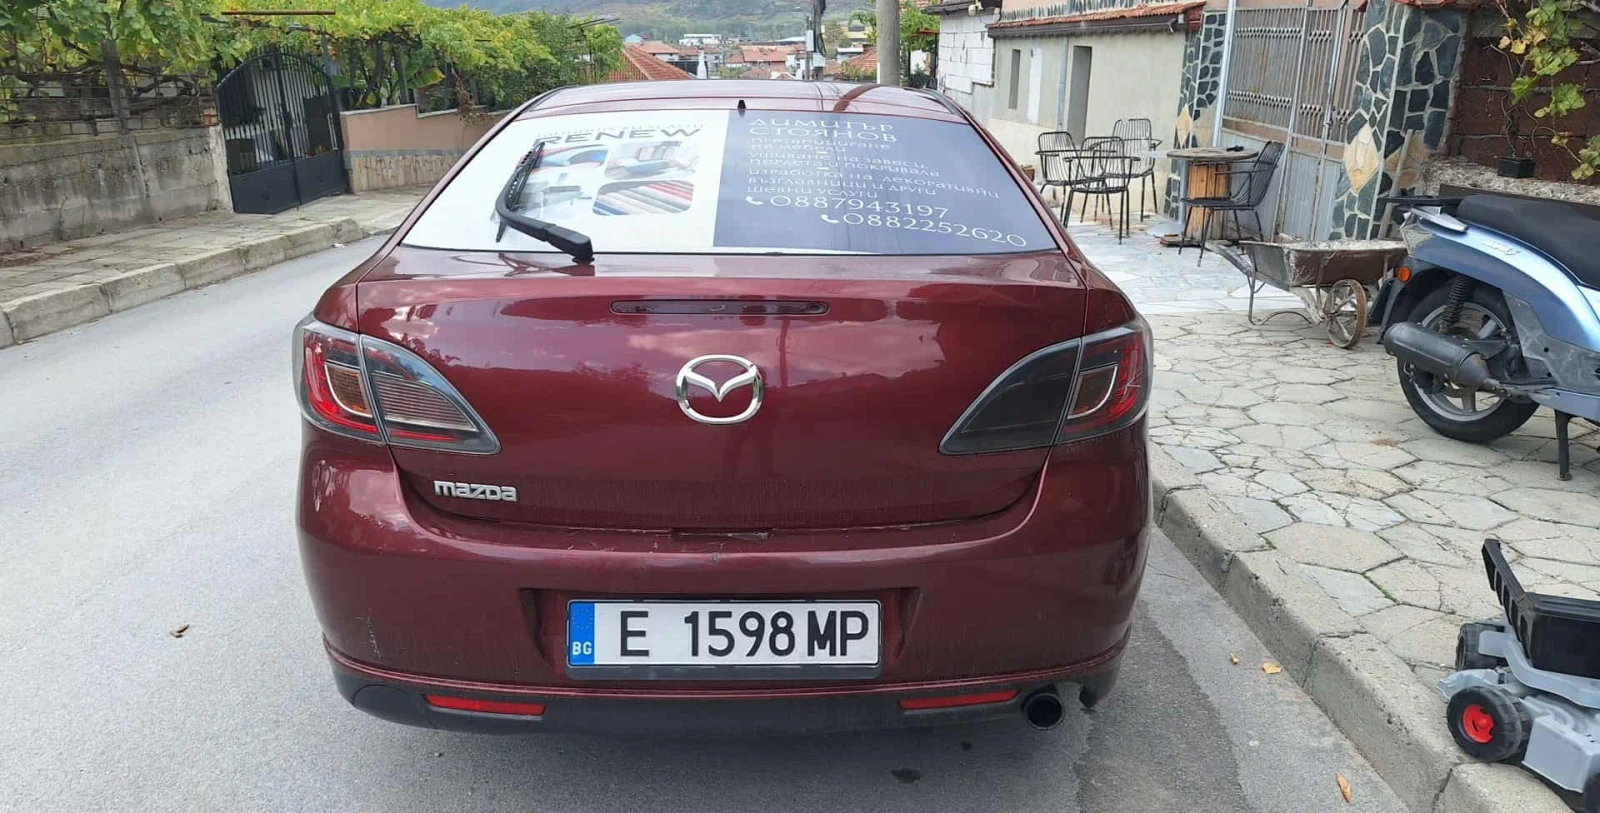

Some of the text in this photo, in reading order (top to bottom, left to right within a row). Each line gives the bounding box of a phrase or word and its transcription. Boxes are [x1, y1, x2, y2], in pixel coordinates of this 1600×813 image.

[533, 129, 700, 146] RENEW
[770, 195, 949, 219] 0887943197
[843, 213, 1027, 247] 0882252620
[684, 611, 796, 657] 1598
[572, 641, 592, 655] BG
